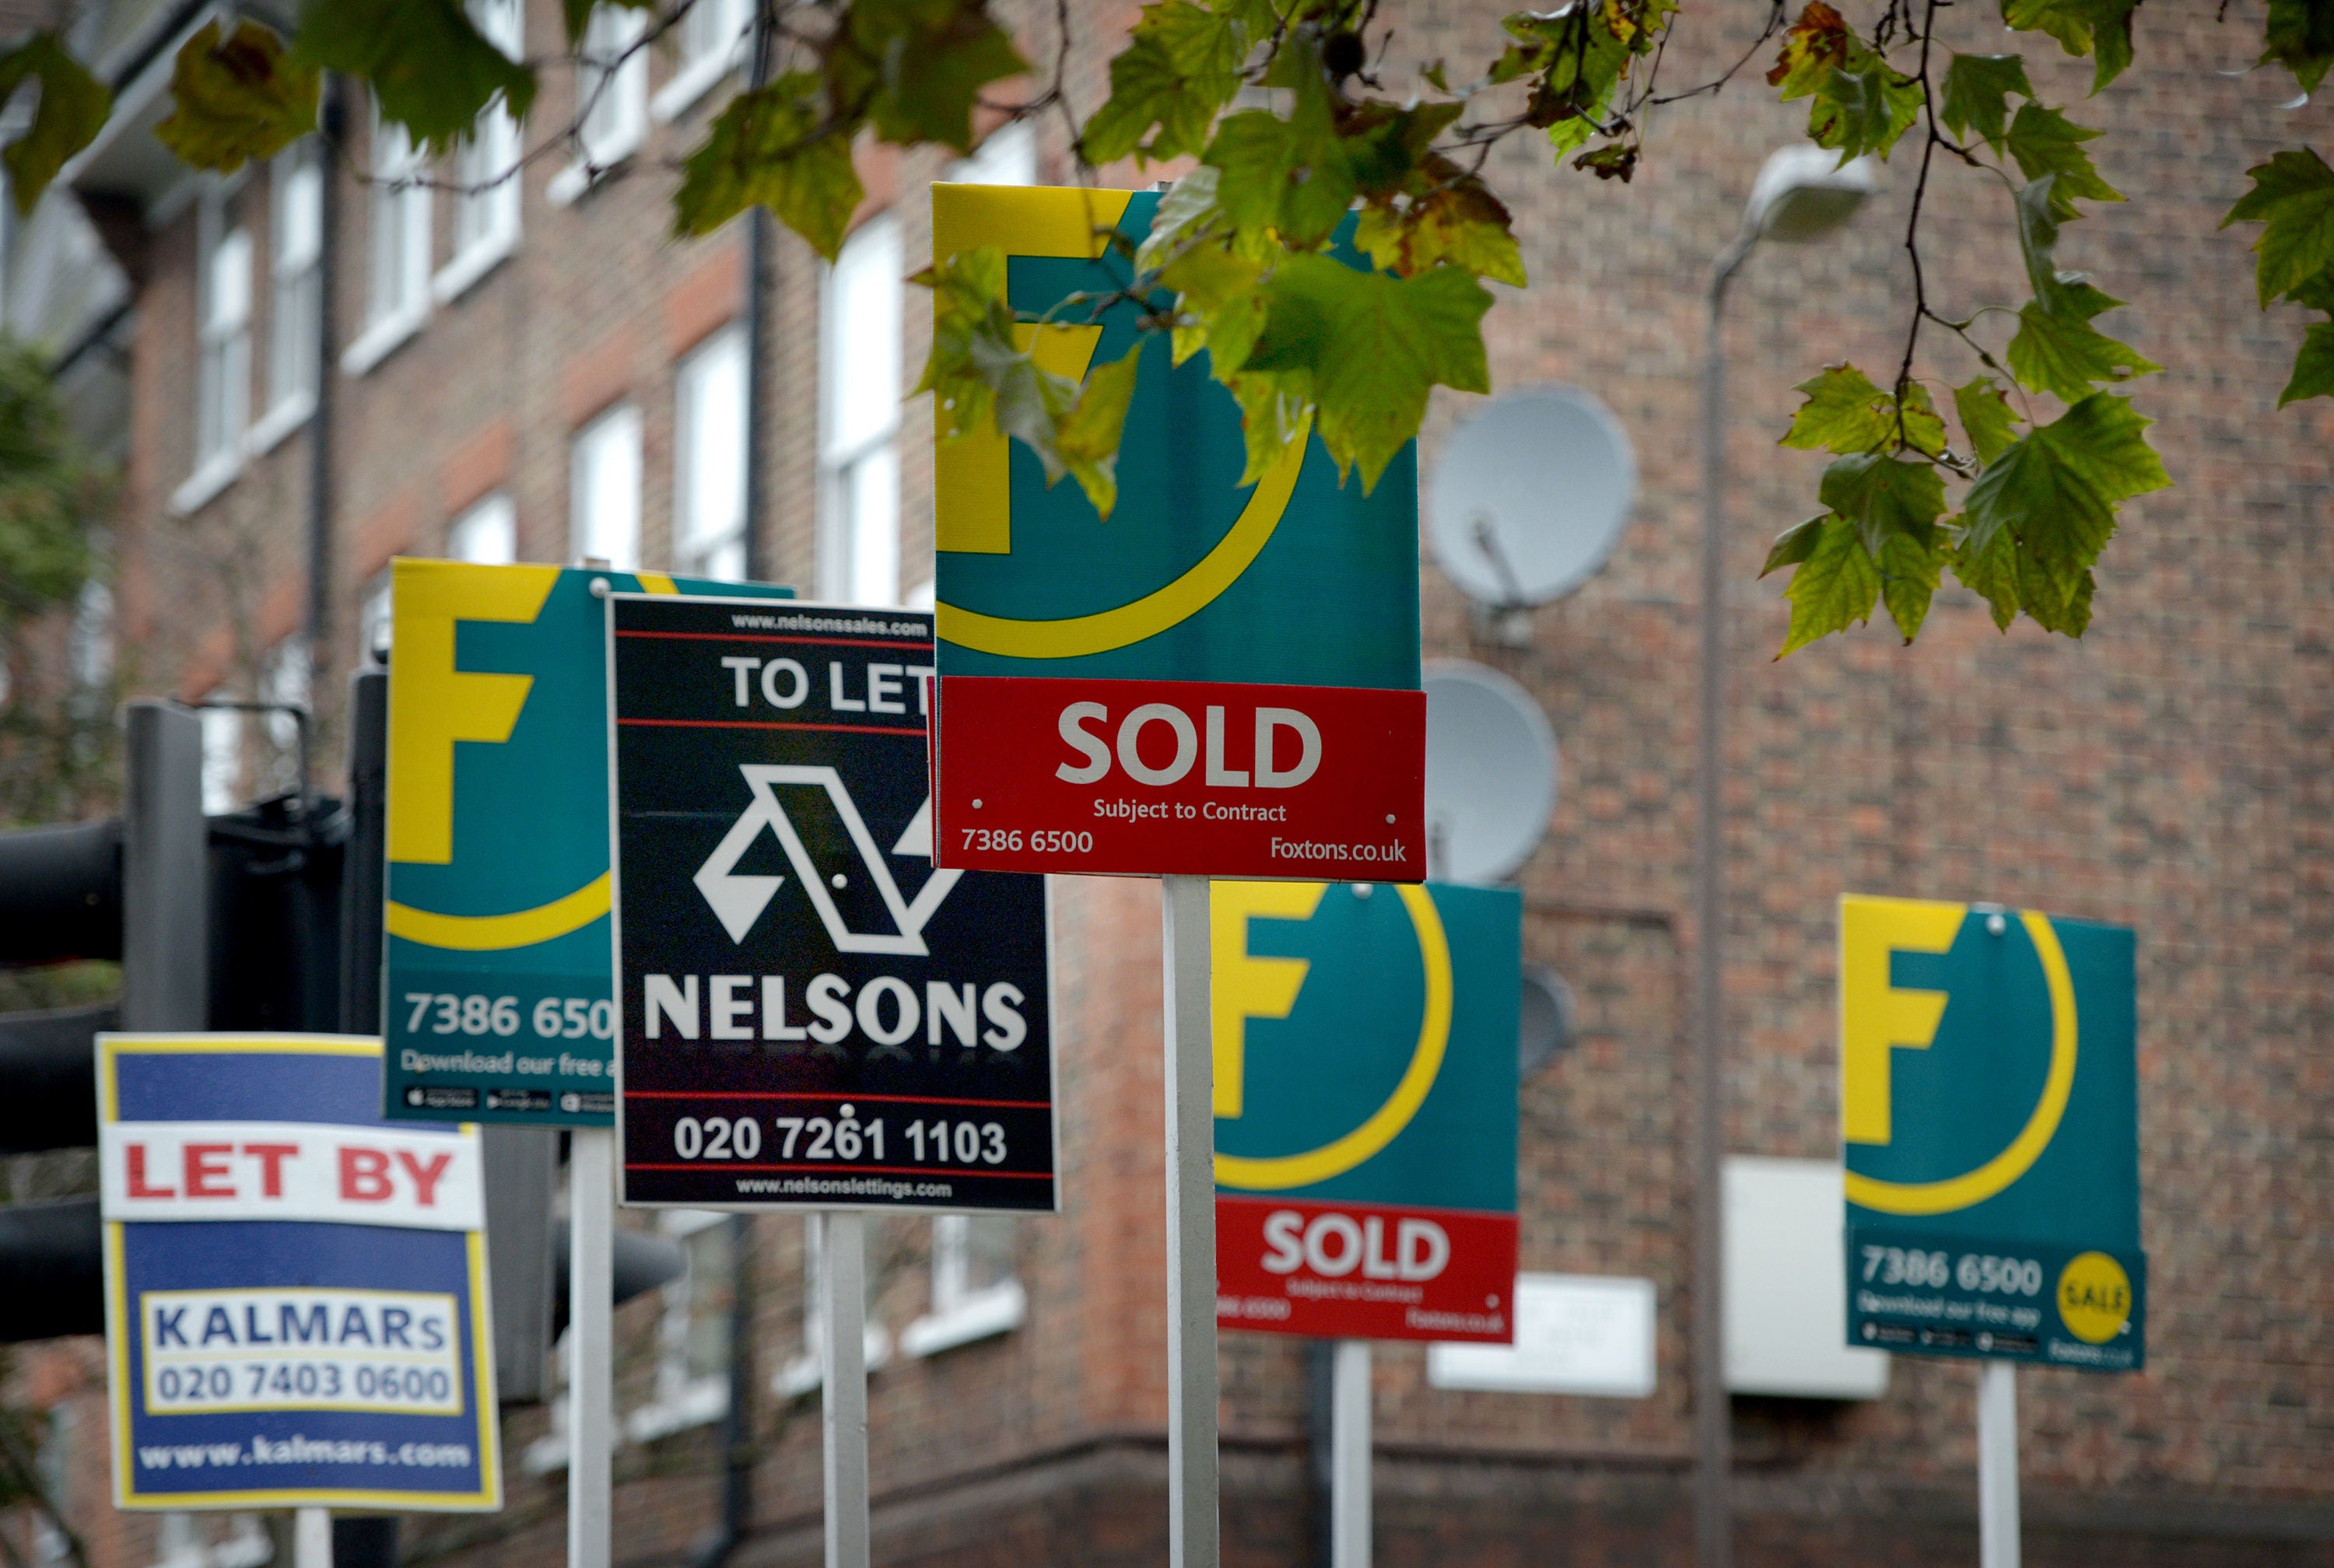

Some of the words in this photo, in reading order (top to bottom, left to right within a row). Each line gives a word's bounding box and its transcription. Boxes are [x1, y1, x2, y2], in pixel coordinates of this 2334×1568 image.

[731, 613, 928, 637] www.nelsonssales.com
[720, 656, 810, 709] TO
[829, 661, 935, 716] LET
[1054, 701, 1323, 789] SOLD
[1093, 798, 1169, 823] Subject
[1174, 802, 1197, 819] to
[1202, 801, 1288, 822] Contract
[961, 828, 1024, 852] 7386
[1030, 830, 1093, 853] 6500
[1270, 836, 1407, 862] Foxtons.co.uk
[405, 992, 521, 1037] 7386
[644, 972, 1028, 1052] NELSONS
[400, 1048, 514, 1074] Download
[516, 1057, 556, 1076] our
[558, 1052, 604, 1077] free
[674, 1116, 762, 1160] 020
[776, 1117, 885, 1160] 7261
[904, 1118, 1008, 1164] 1103
[124, 1143, 301, 1201] LET
[337, 1146, 454, 1208] BY
[734, 1176, 953, 1199] www.nelsonslettings.com
[1260, 1209, 1452, 1282] SOLD
[1860, 1245, 1950, 1289] 7386
[1955, 1253, 2044, 1297] 6500
[2064, 1282, 2126, 1314] SALE
[158, 1365, 233, 1401] 020
[247, 1363, 343, 1398] 7403
[355, 1364, 451, 1402] 0600
[138, 1433, 471, 1469] www.kalmars.com
